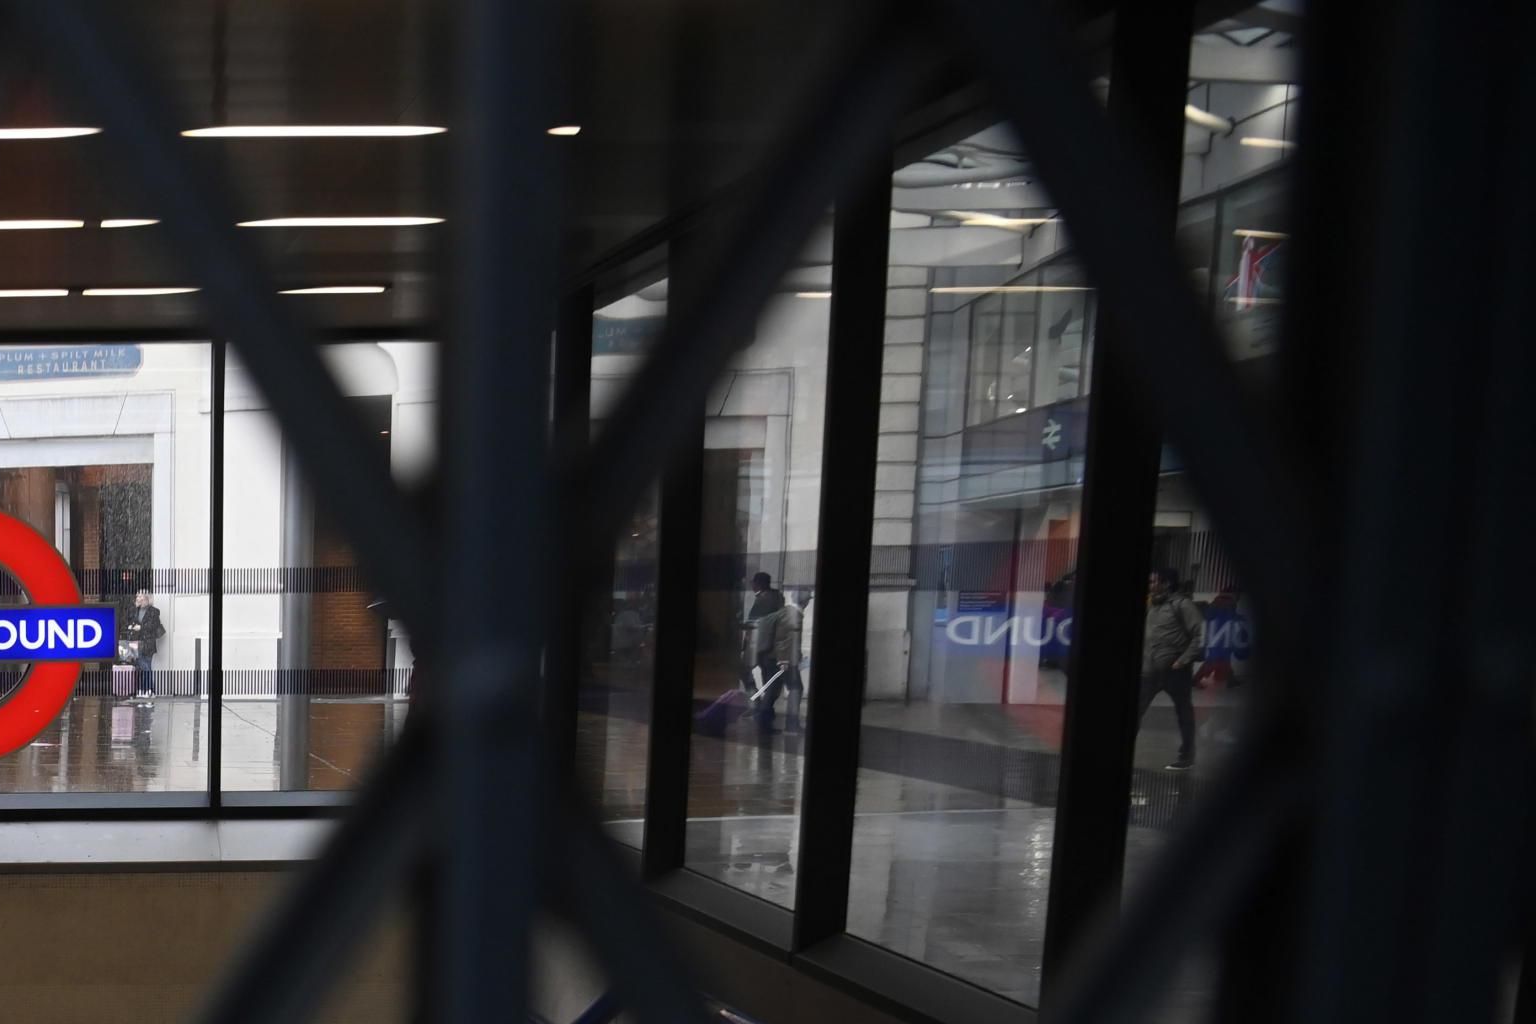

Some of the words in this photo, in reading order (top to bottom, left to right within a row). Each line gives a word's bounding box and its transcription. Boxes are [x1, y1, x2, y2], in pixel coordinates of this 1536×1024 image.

[51, 350, 88, 360] SPILT
[93, 348, 126, 358] MILK
[17, 359, 106, 375] RESTAURANT
